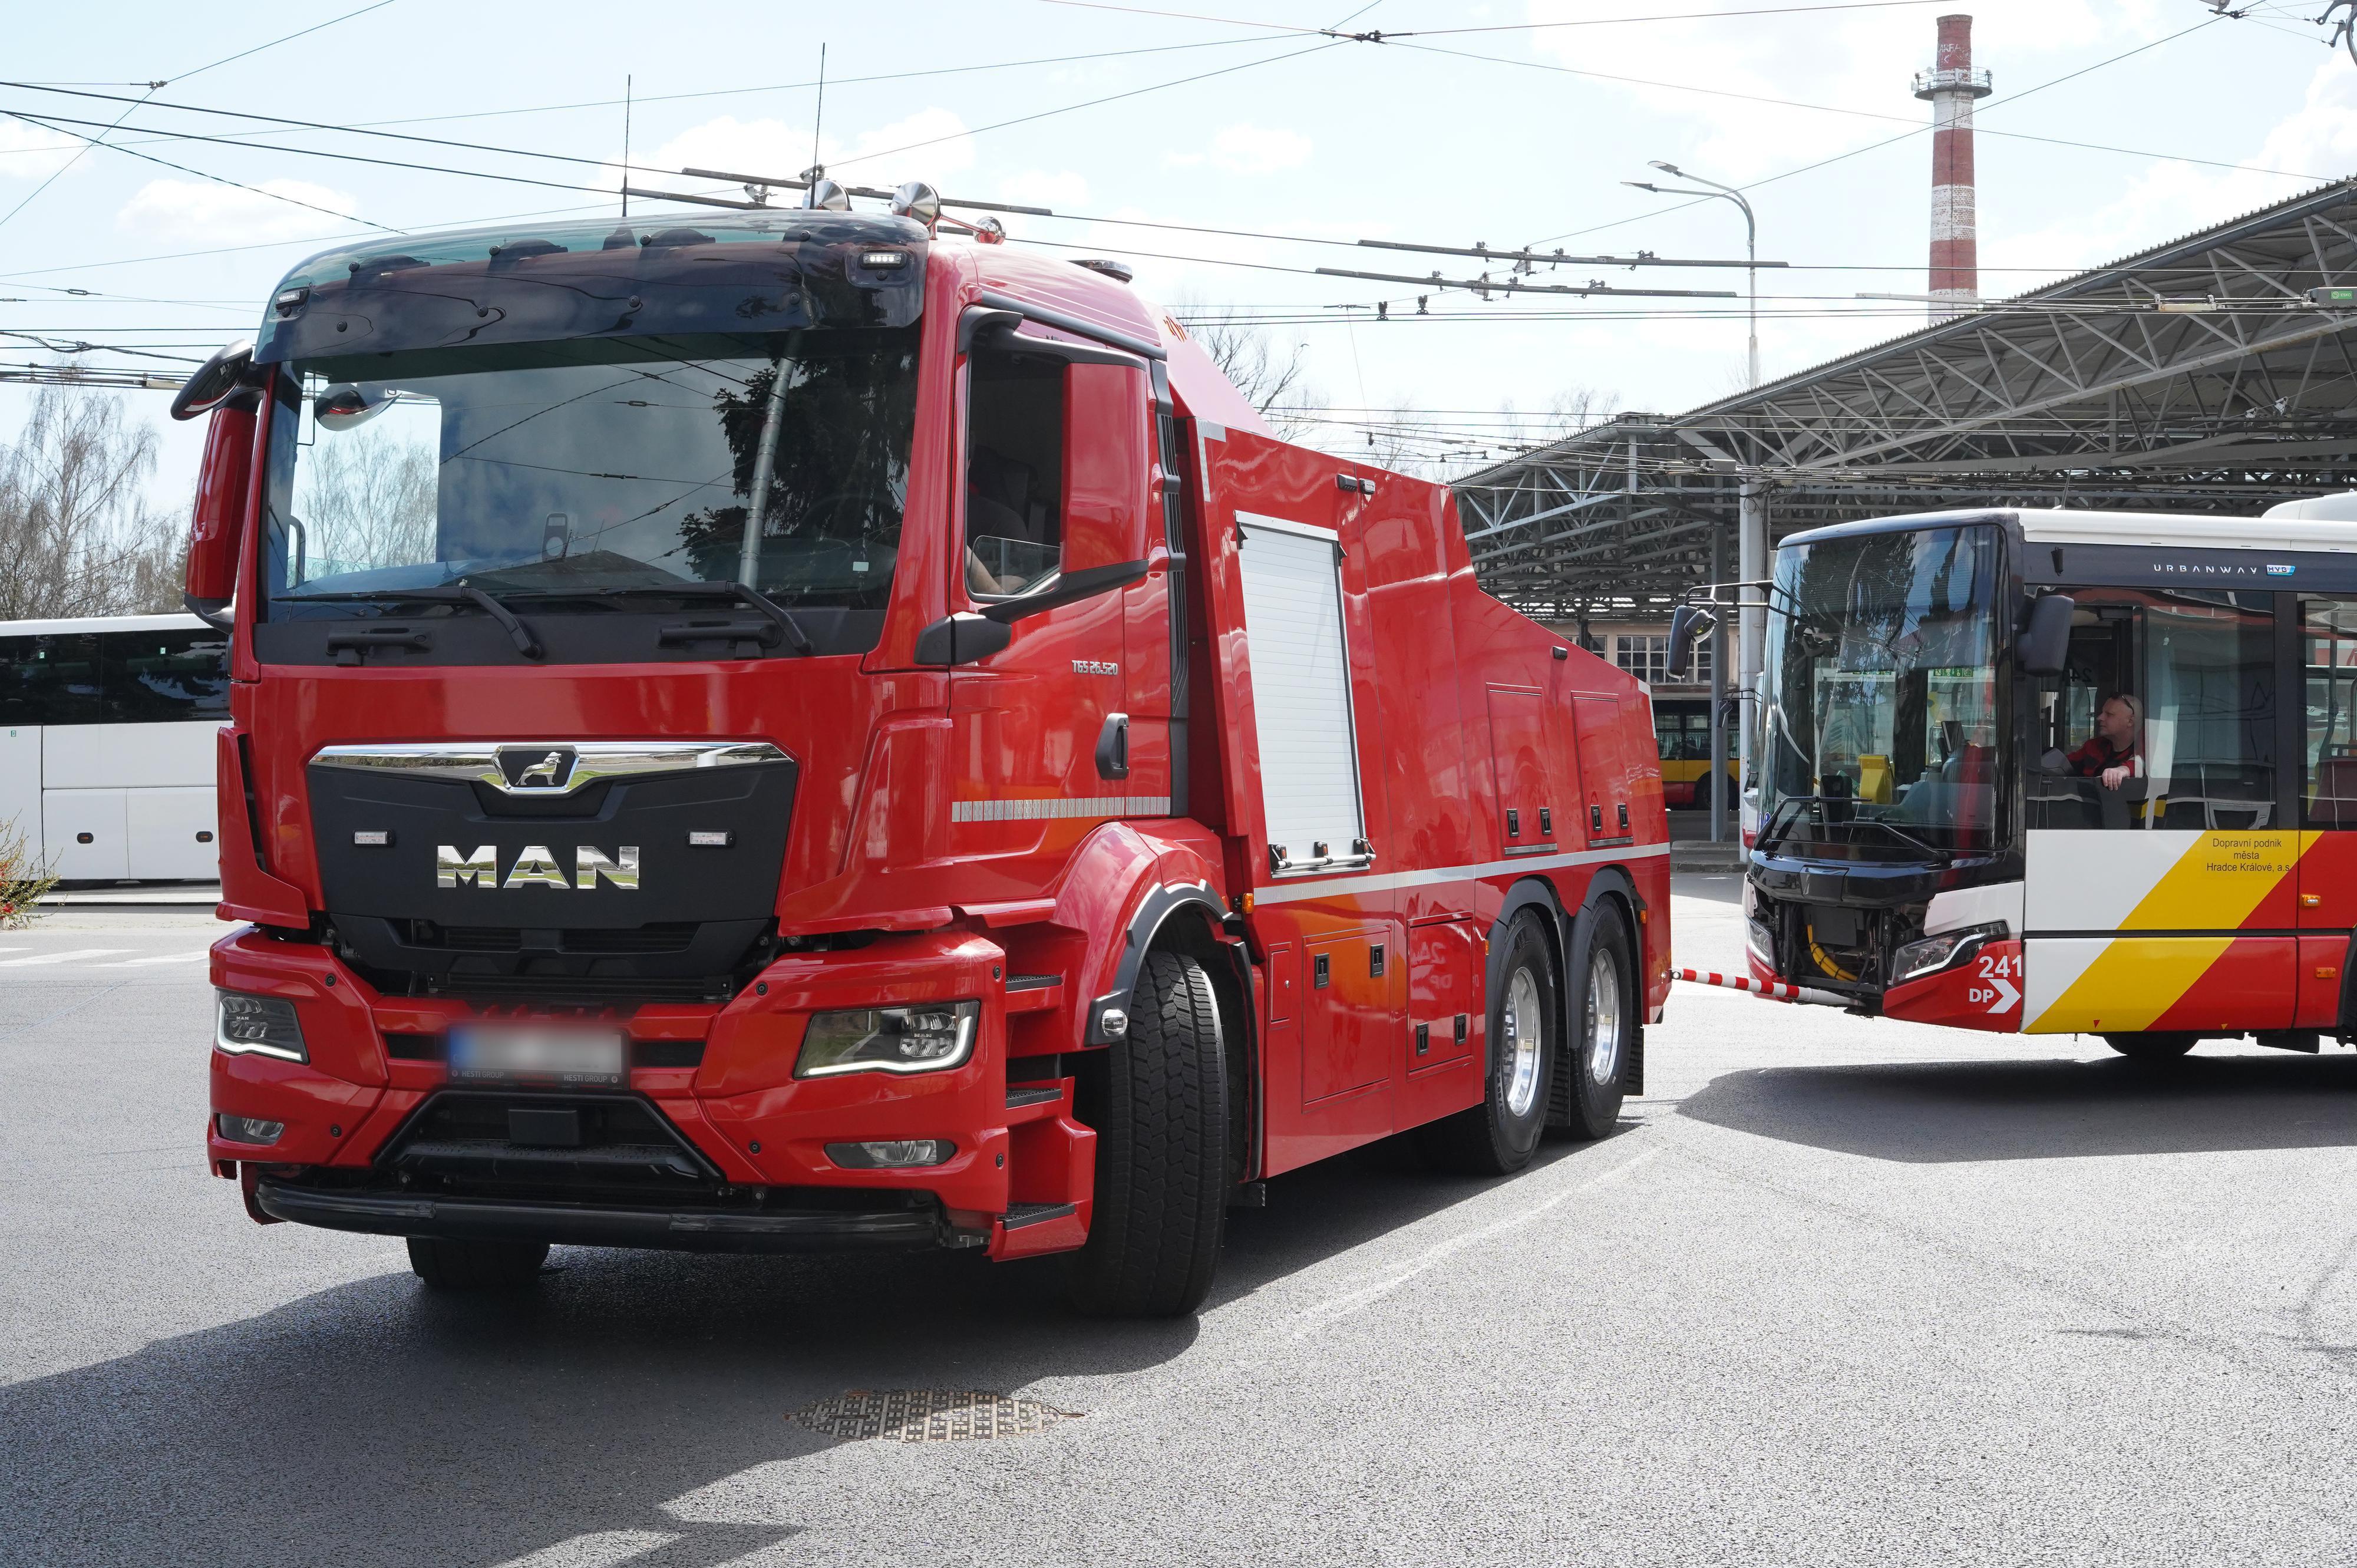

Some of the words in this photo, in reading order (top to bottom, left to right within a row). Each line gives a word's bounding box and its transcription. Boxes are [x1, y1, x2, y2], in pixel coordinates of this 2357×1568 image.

[2154, 564, 2257, 575] URBANWAY
[1072, 660, 1088, 674] TGS
[1090, 661, 1118, 676] 26.520
[2213, 839, 2251, 849] Dopravní
[2254, 839, 2282, 849] podnik
[2233, 851, 2259, 859] města
[438, 845, 639, 889] MAN
[2207, 863, 2237, 872] Hradce
[2240, 863, 2275, 872] Králové,
[1979, 955, 2022, 978] 241
[1969, 988, 1994, 1003] DP
